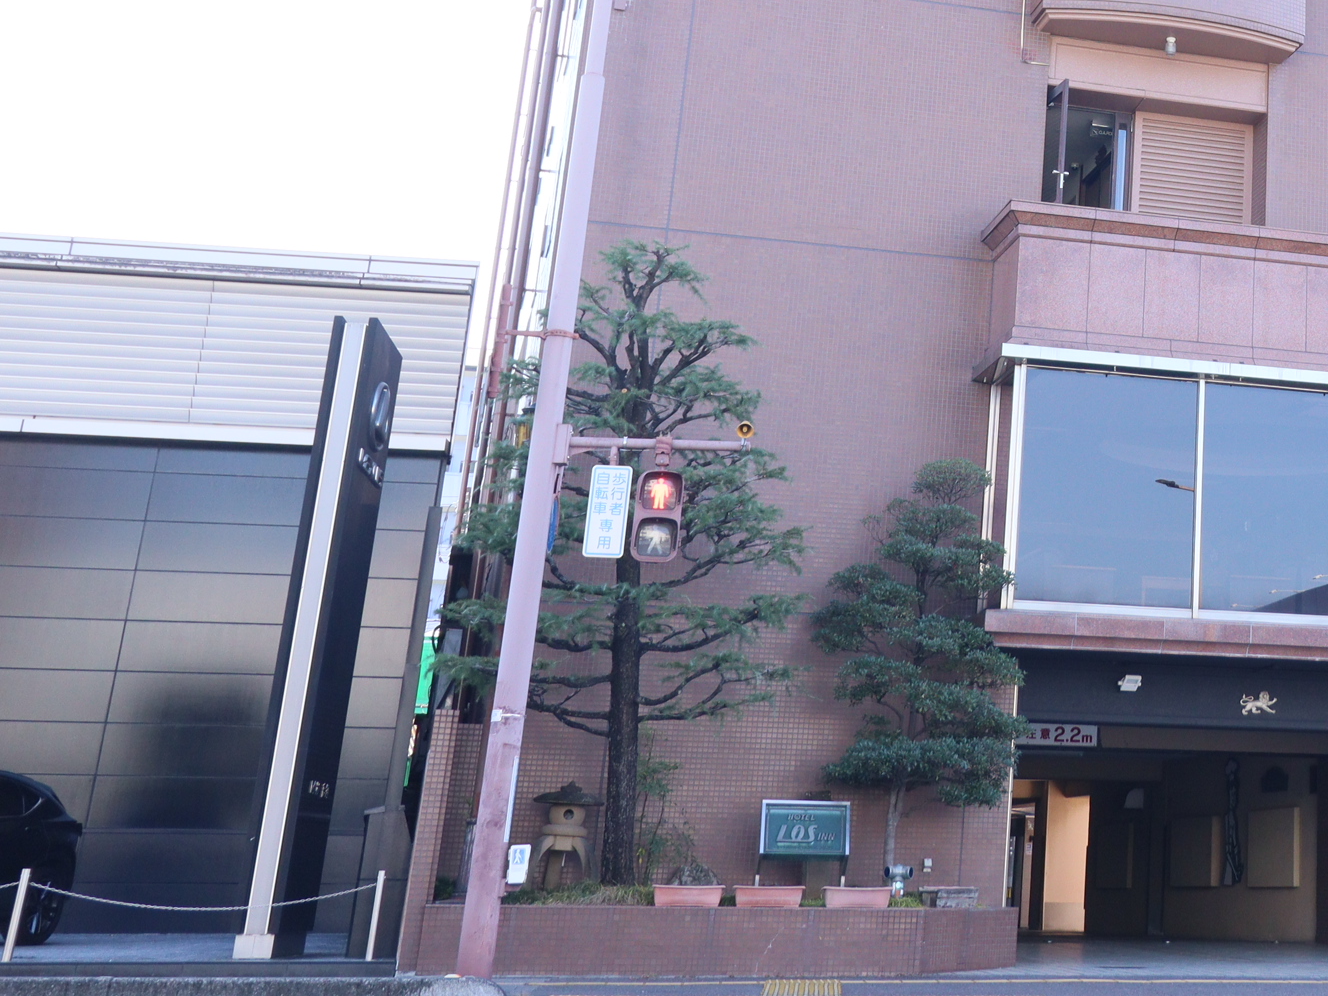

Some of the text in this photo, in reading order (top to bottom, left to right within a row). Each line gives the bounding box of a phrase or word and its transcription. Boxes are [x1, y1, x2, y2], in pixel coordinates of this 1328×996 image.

[593, 471, 610, 515] 自転車
[609, 472, 627, 516] 歩行者
[597, 519, 614, 550] 専用
[1054, 726, 1093, 743] 2.2m
[776, 824, 836, 842] LOS INN
